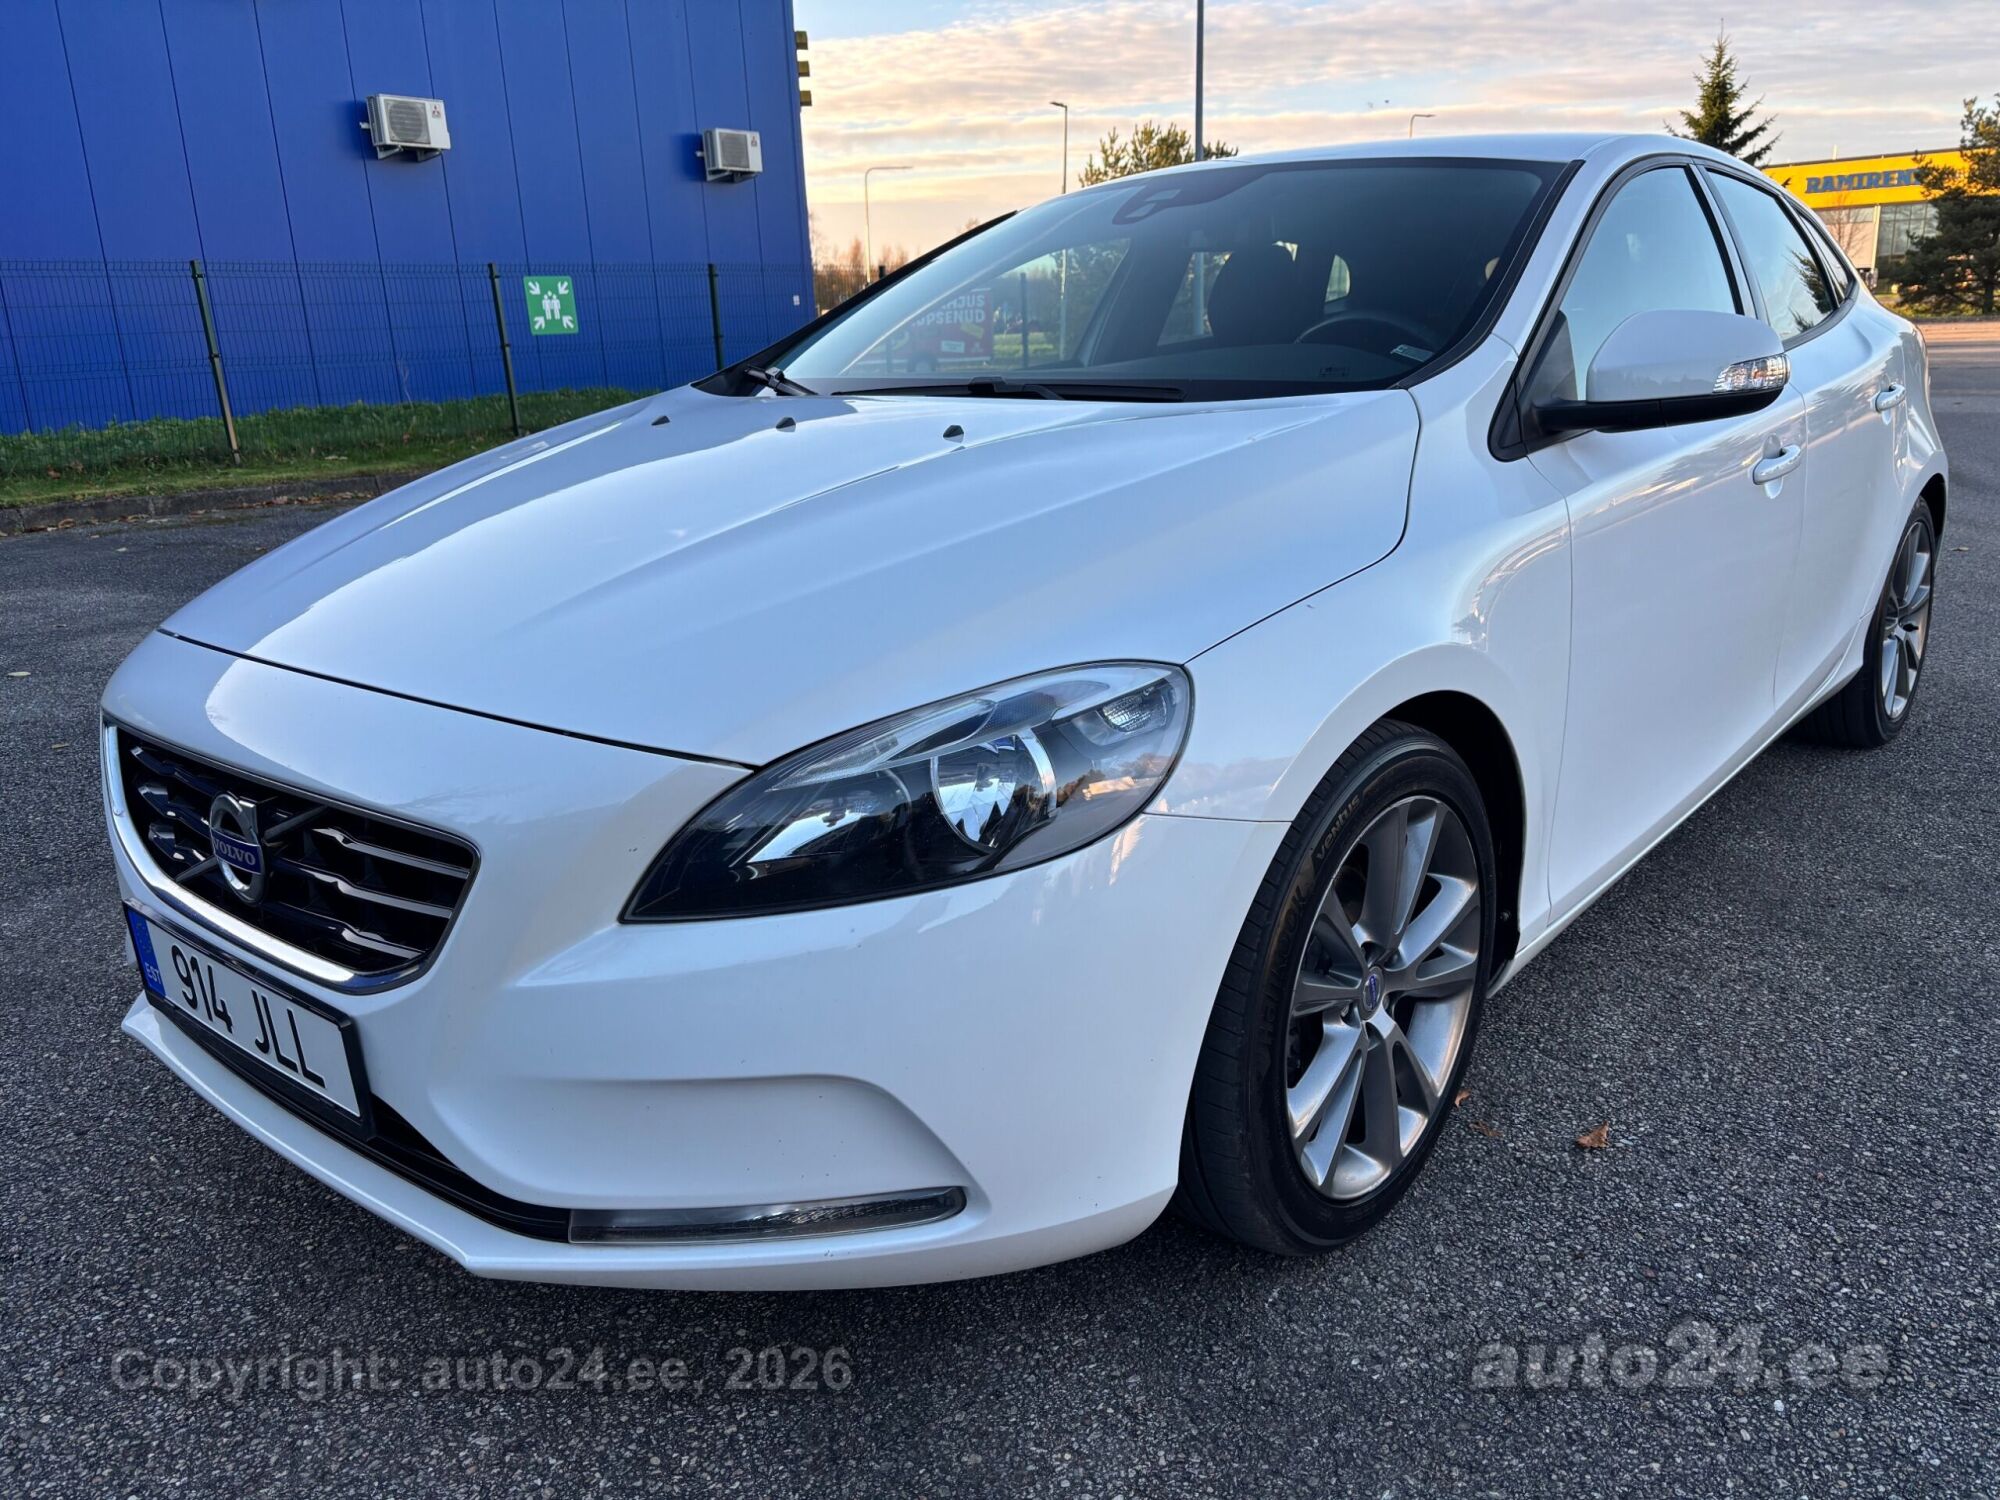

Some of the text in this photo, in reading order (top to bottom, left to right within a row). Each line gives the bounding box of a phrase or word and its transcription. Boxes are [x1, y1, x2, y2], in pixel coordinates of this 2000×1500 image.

[942, 295, 985, 310] HJUS
[911, 308, 986, 327] PSENUD
[214, 839, 256, 866] VOLVO
[144, 962, 162, 985] EST
[171, 944, 326, 1089] 914 JLL
